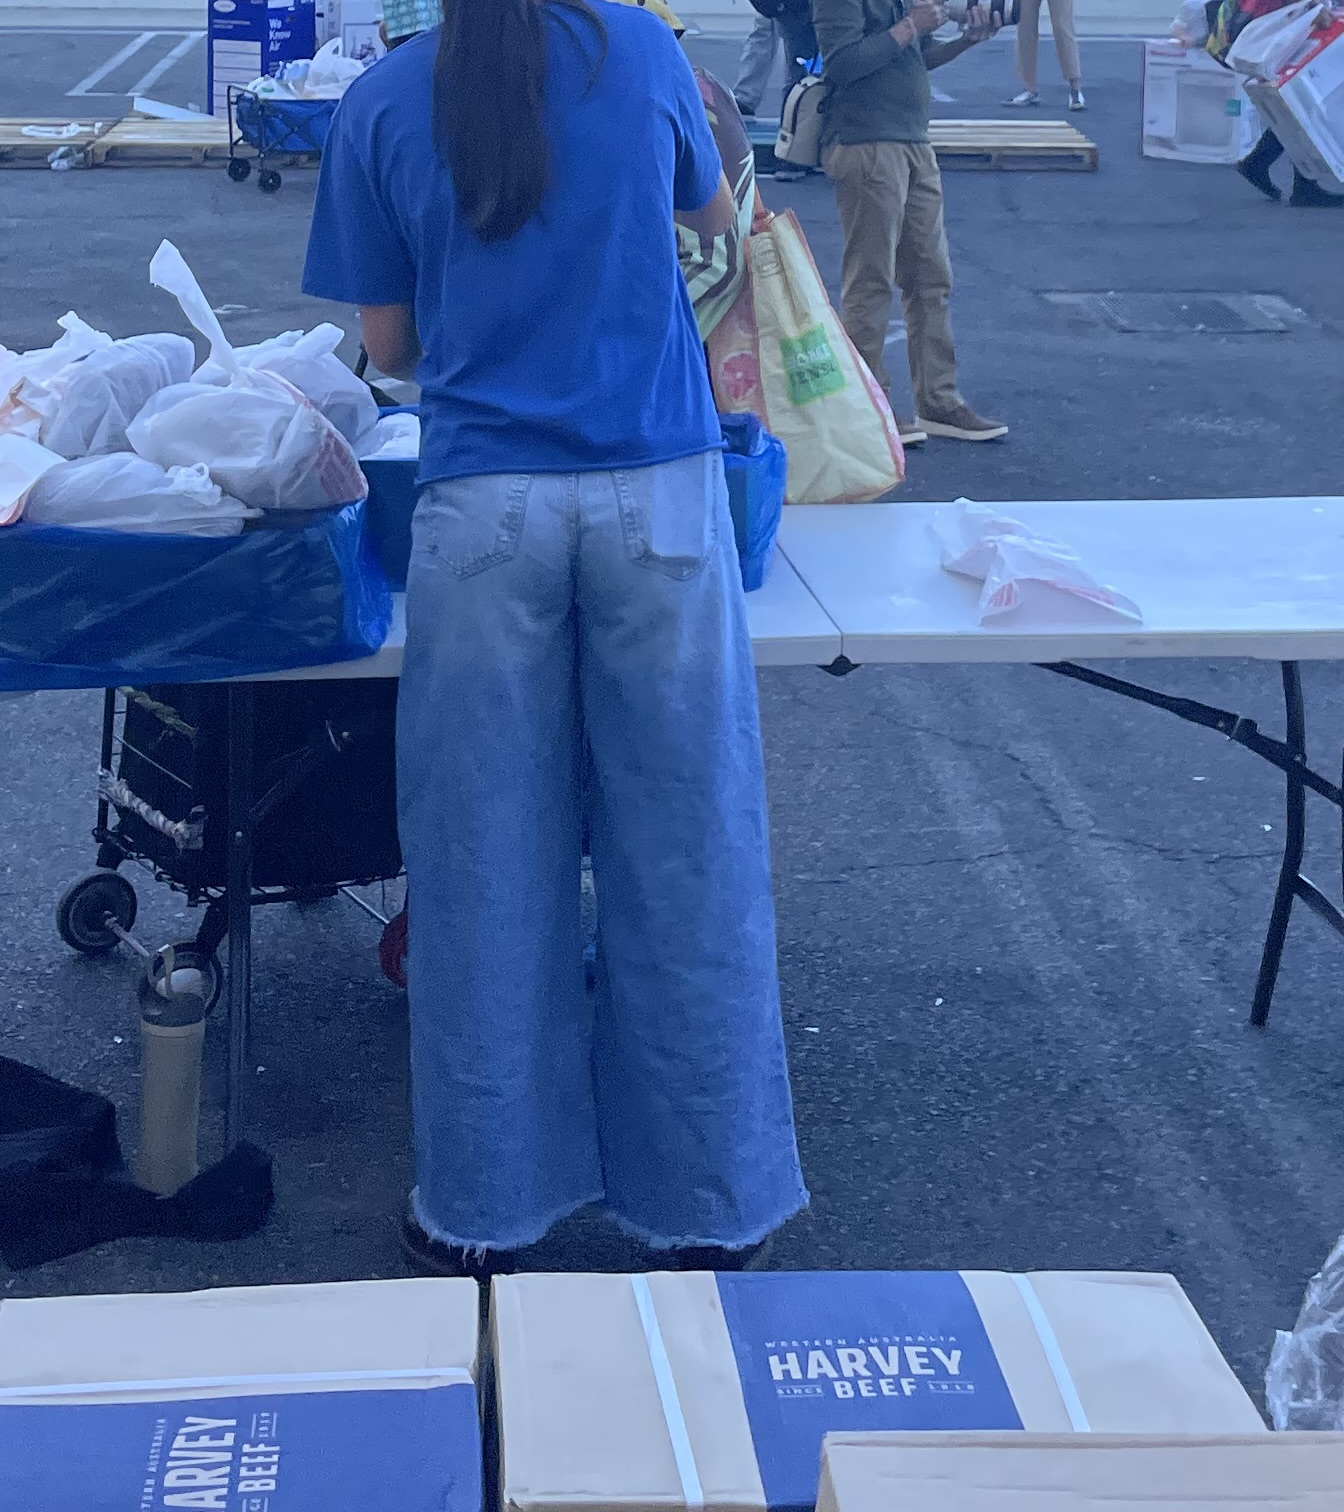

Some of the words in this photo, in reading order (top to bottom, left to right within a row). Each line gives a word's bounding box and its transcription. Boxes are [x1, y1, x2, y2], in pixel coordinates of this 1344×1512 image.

[768, 1345, 962, 1380] HARVEY
[833, 1378, 918, 1399] BEEF
[237, 1442, 281, 1493] BEEF
